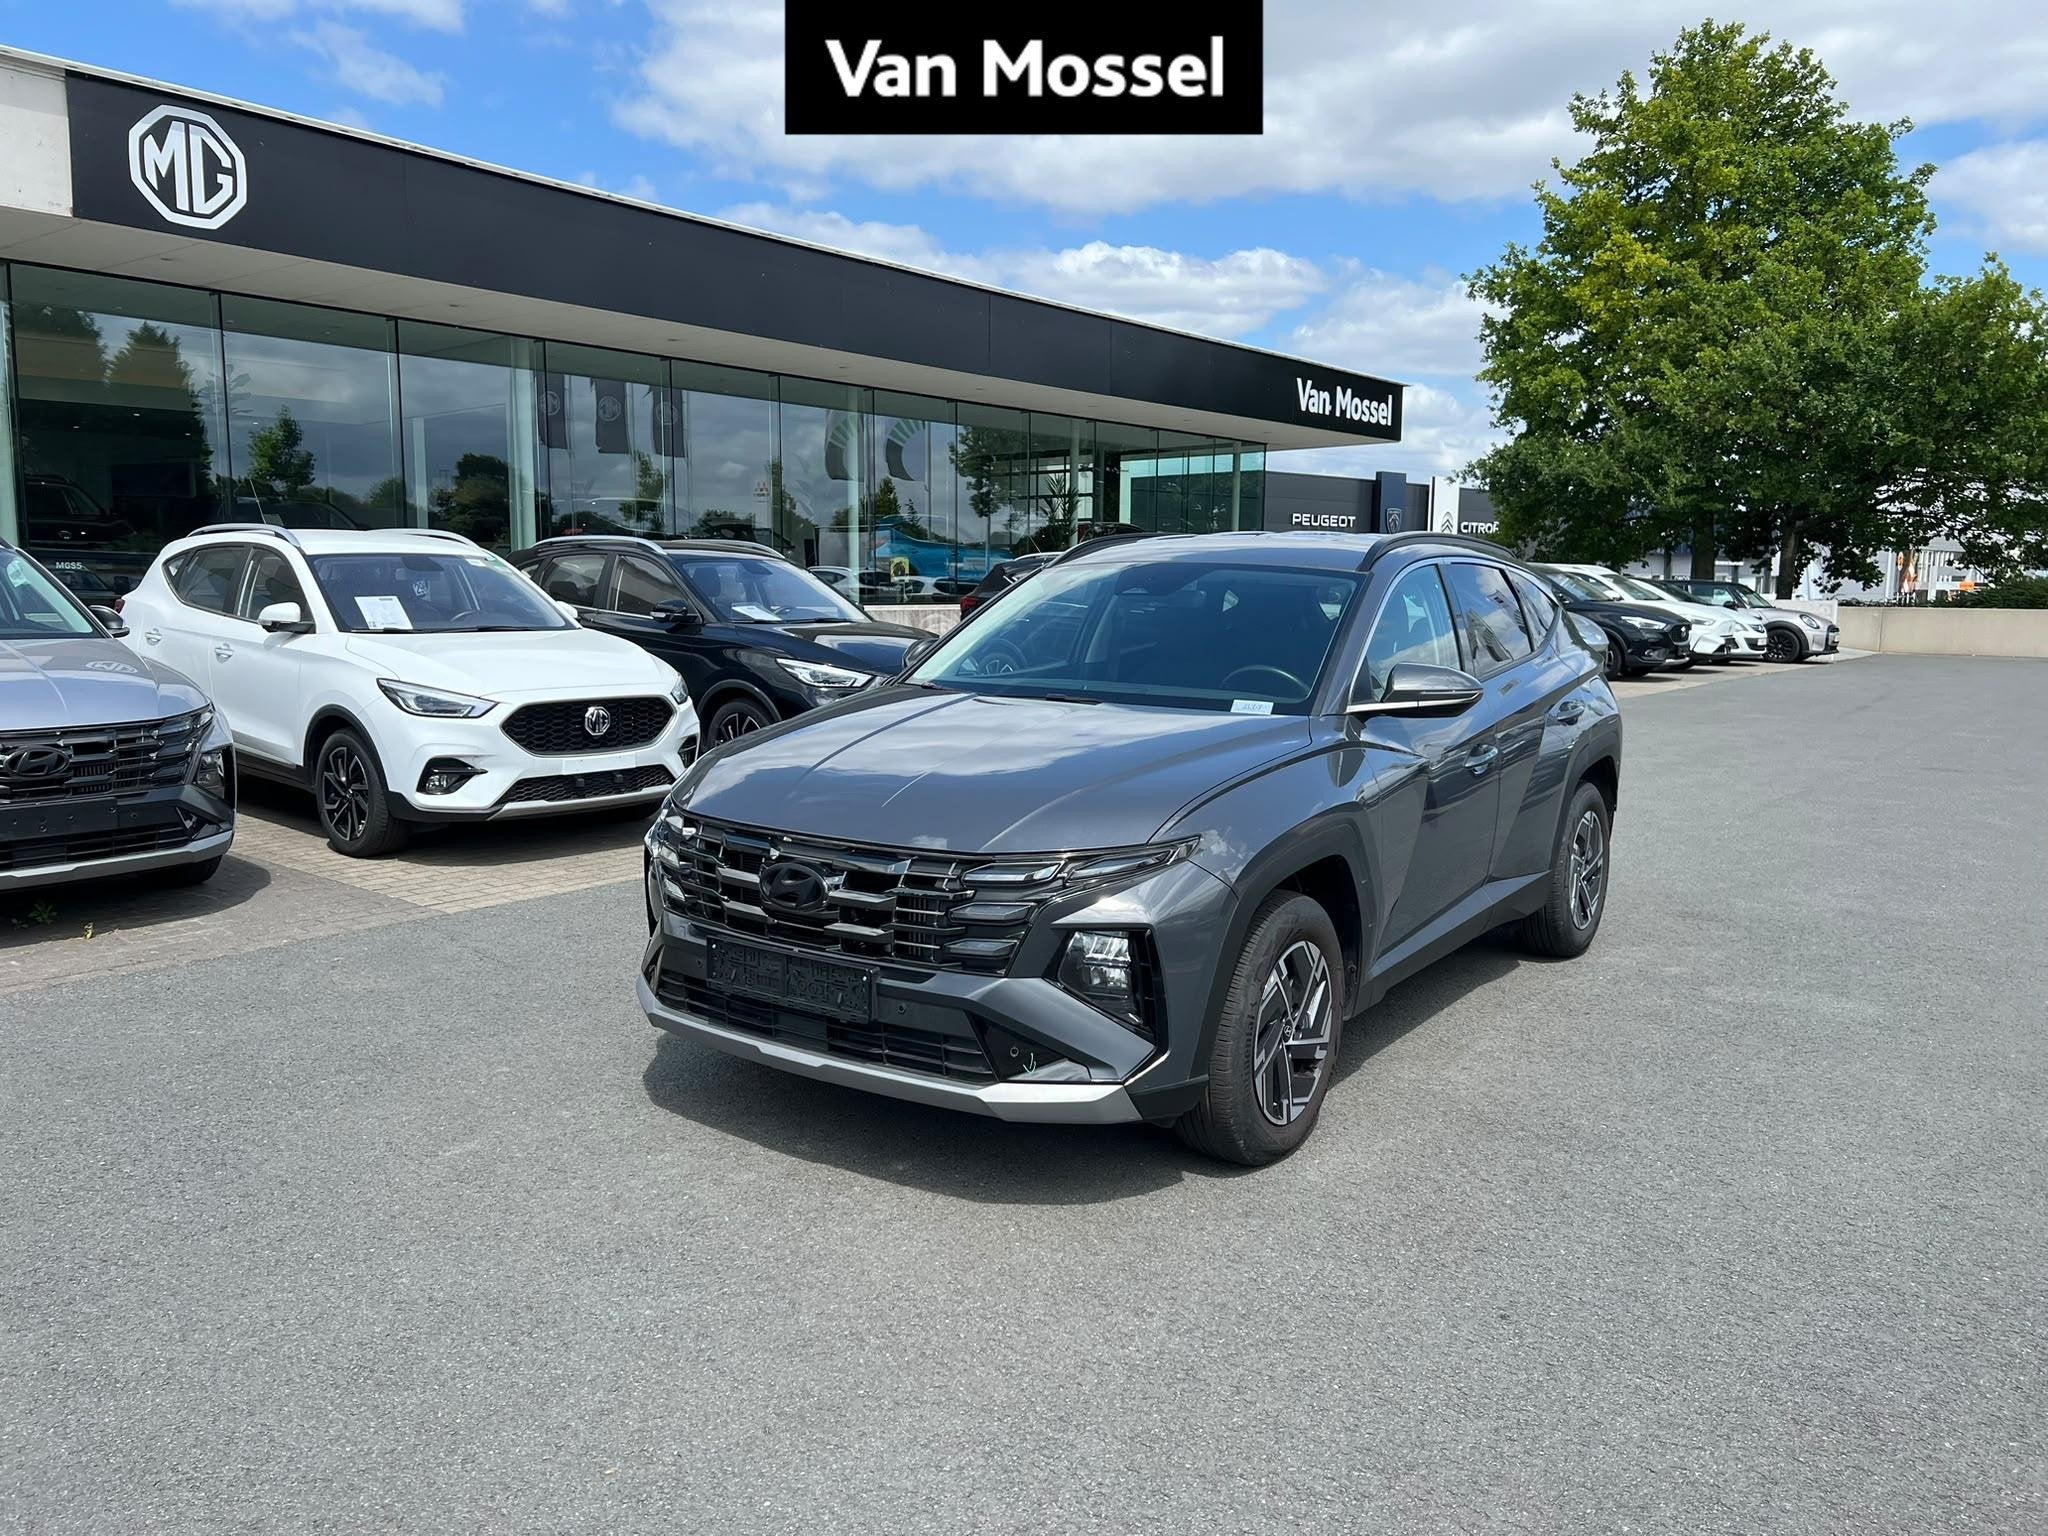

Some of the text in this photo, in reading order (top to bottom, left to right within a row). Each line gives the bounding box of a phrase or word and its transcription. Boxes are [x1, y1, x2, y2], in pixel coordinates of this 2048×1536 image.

[141, 118, 236, 217] MG
[1296, 377, 1393, 427] Van Mossel
[1292, 513, 1356, 528] PEUGEOT
[55, 561, 82, 570] MGS5
[587, 709, 609, 733] MG
